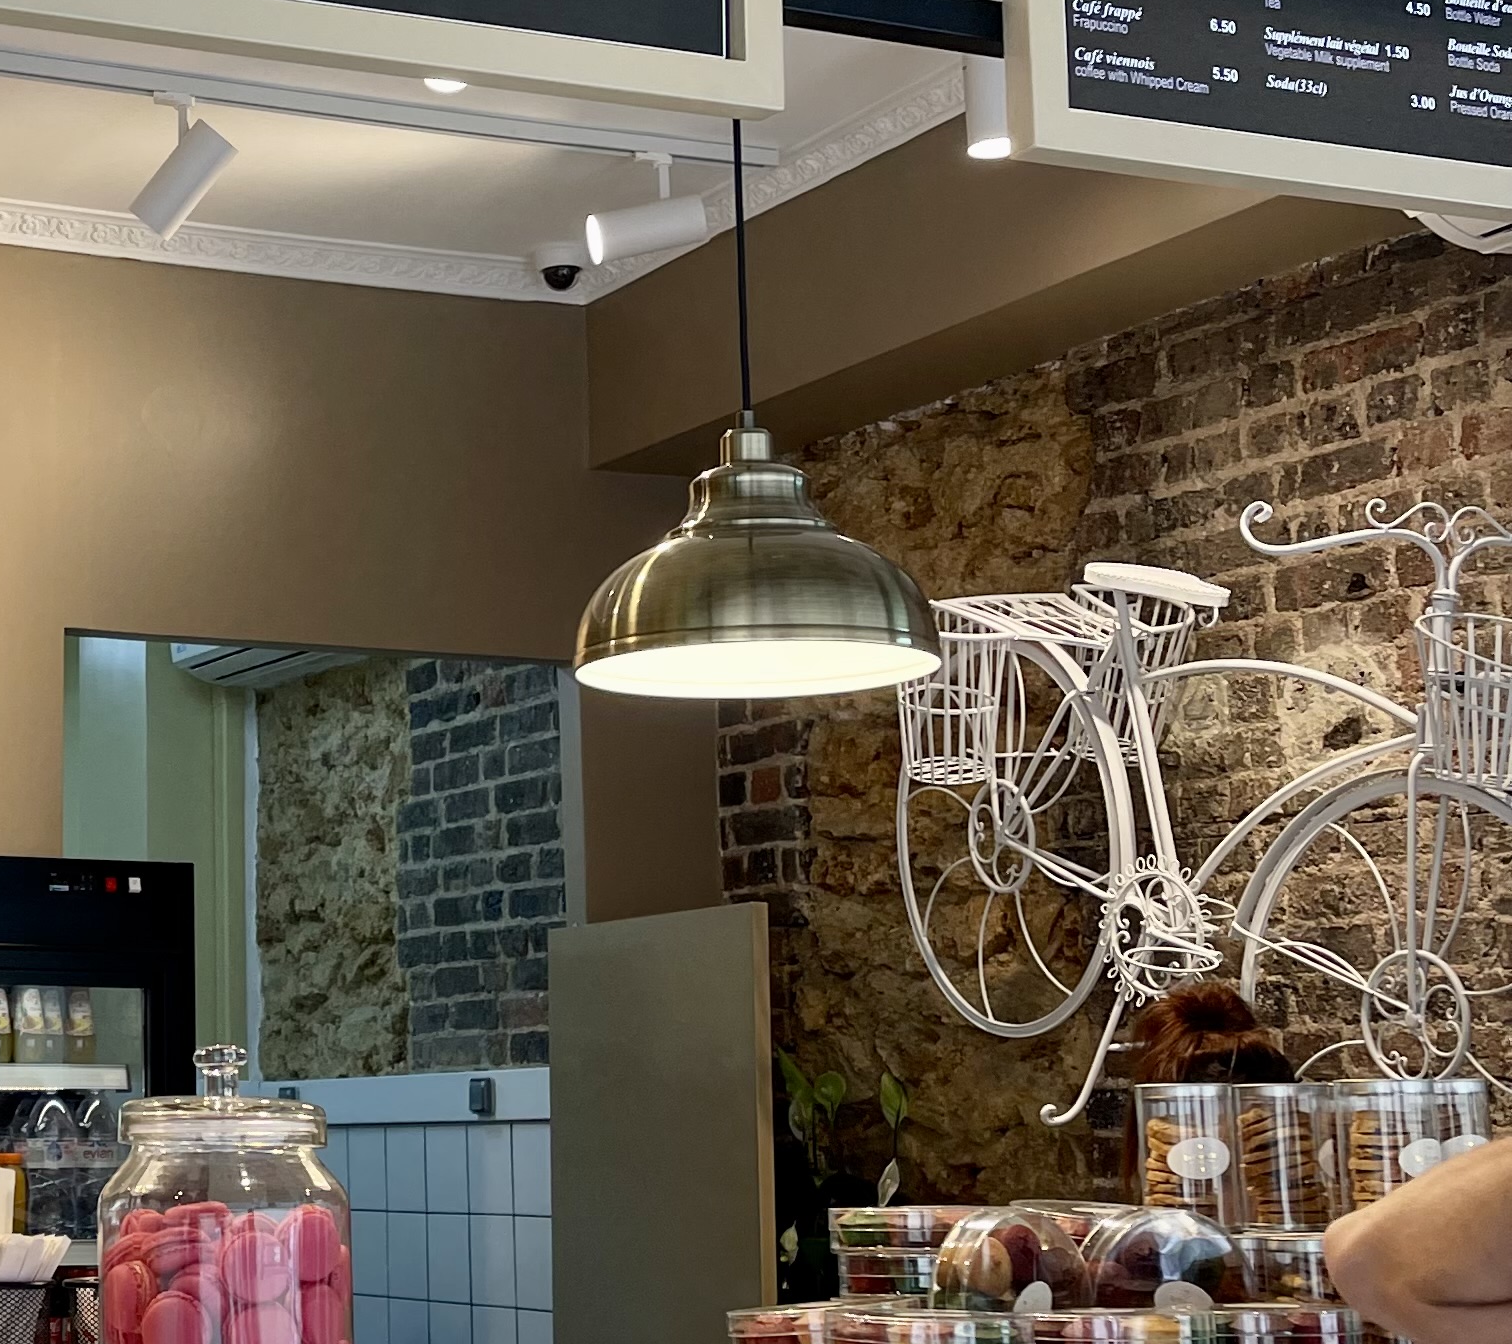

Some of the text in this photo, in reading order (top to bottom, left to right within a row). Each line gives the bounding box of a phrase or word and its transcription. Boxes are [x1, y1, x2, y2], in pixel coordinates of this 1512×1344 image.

[1073, 46, 1155, 70] Café viennois
[83, 1148, 114, 1159] evian
